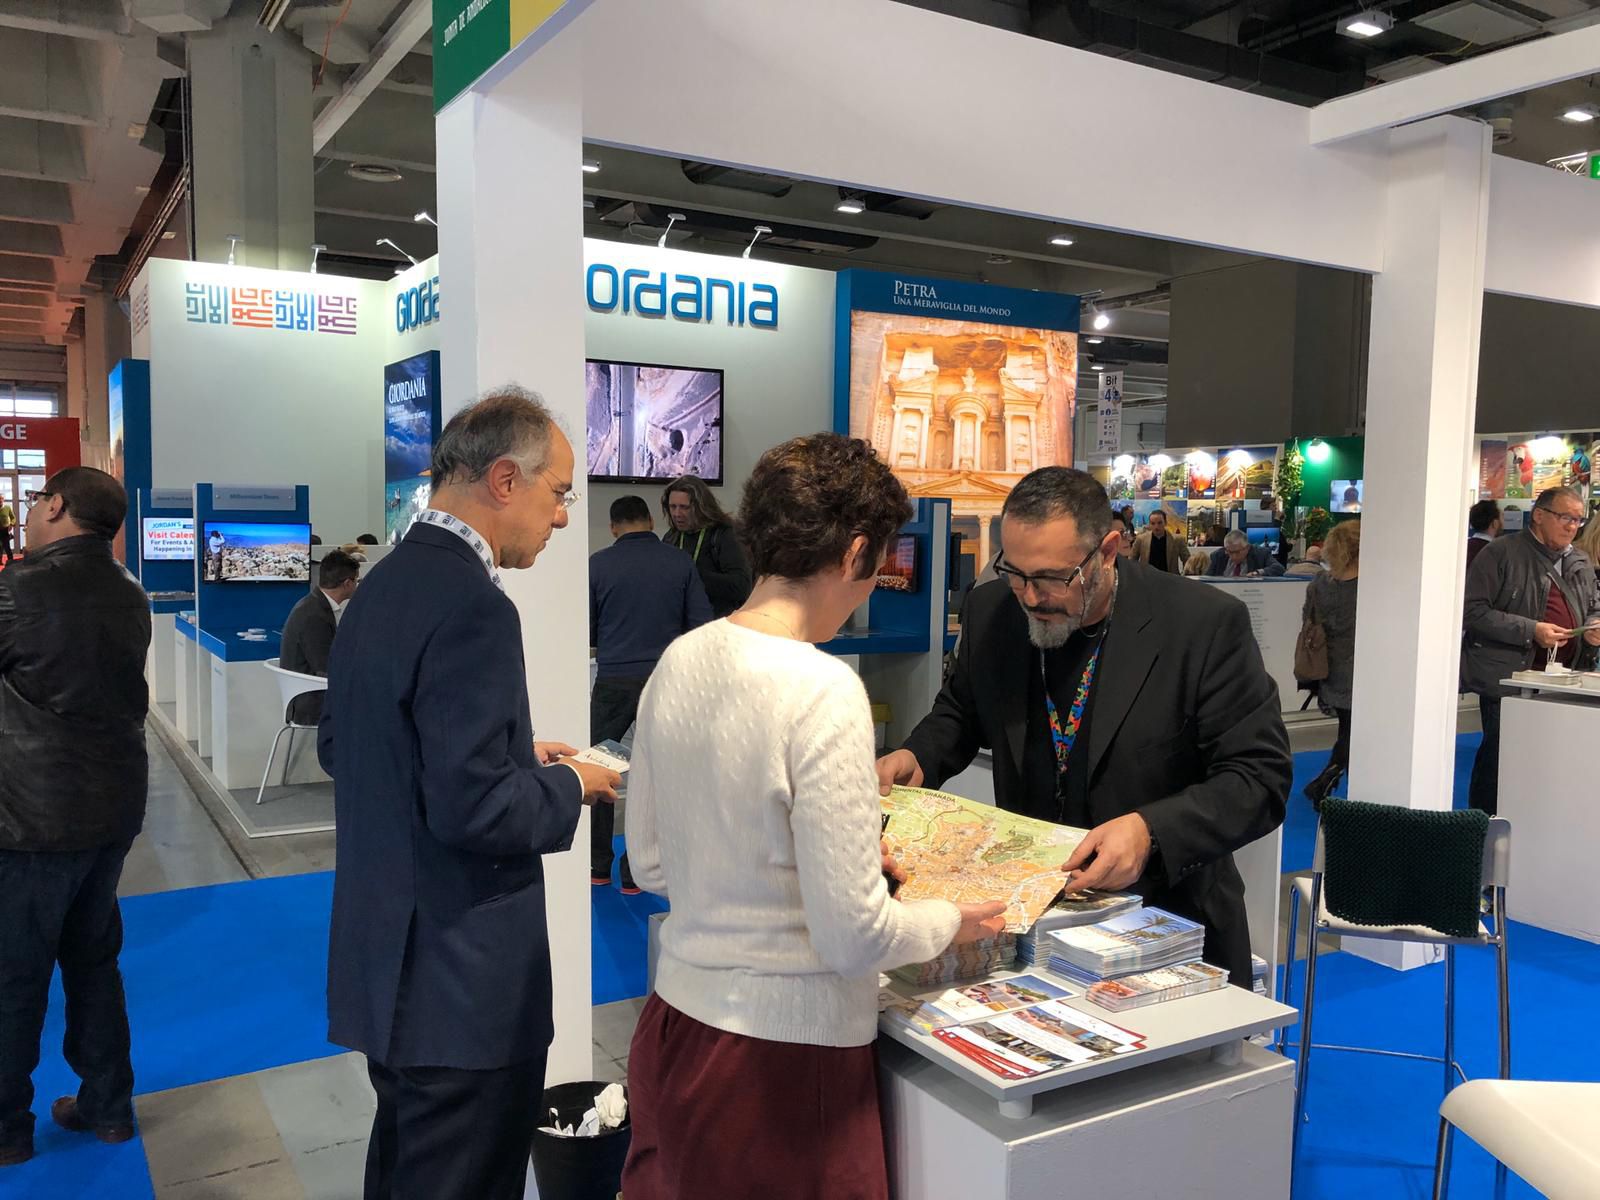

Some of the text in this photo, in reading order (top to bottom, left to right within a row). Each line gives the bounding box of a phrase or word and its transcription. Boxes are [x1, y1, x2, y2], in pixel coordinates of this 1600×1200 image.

[895, 280, 937, 299] PETRA
[893, 295, 1011, 317] UNA MERAVIGLIA DEL MONDO
[1106, 375, 1117, 386] Bit
[388, 377, 426, 404] GIORDANIA
[148, 531, 168, 539] Visit
